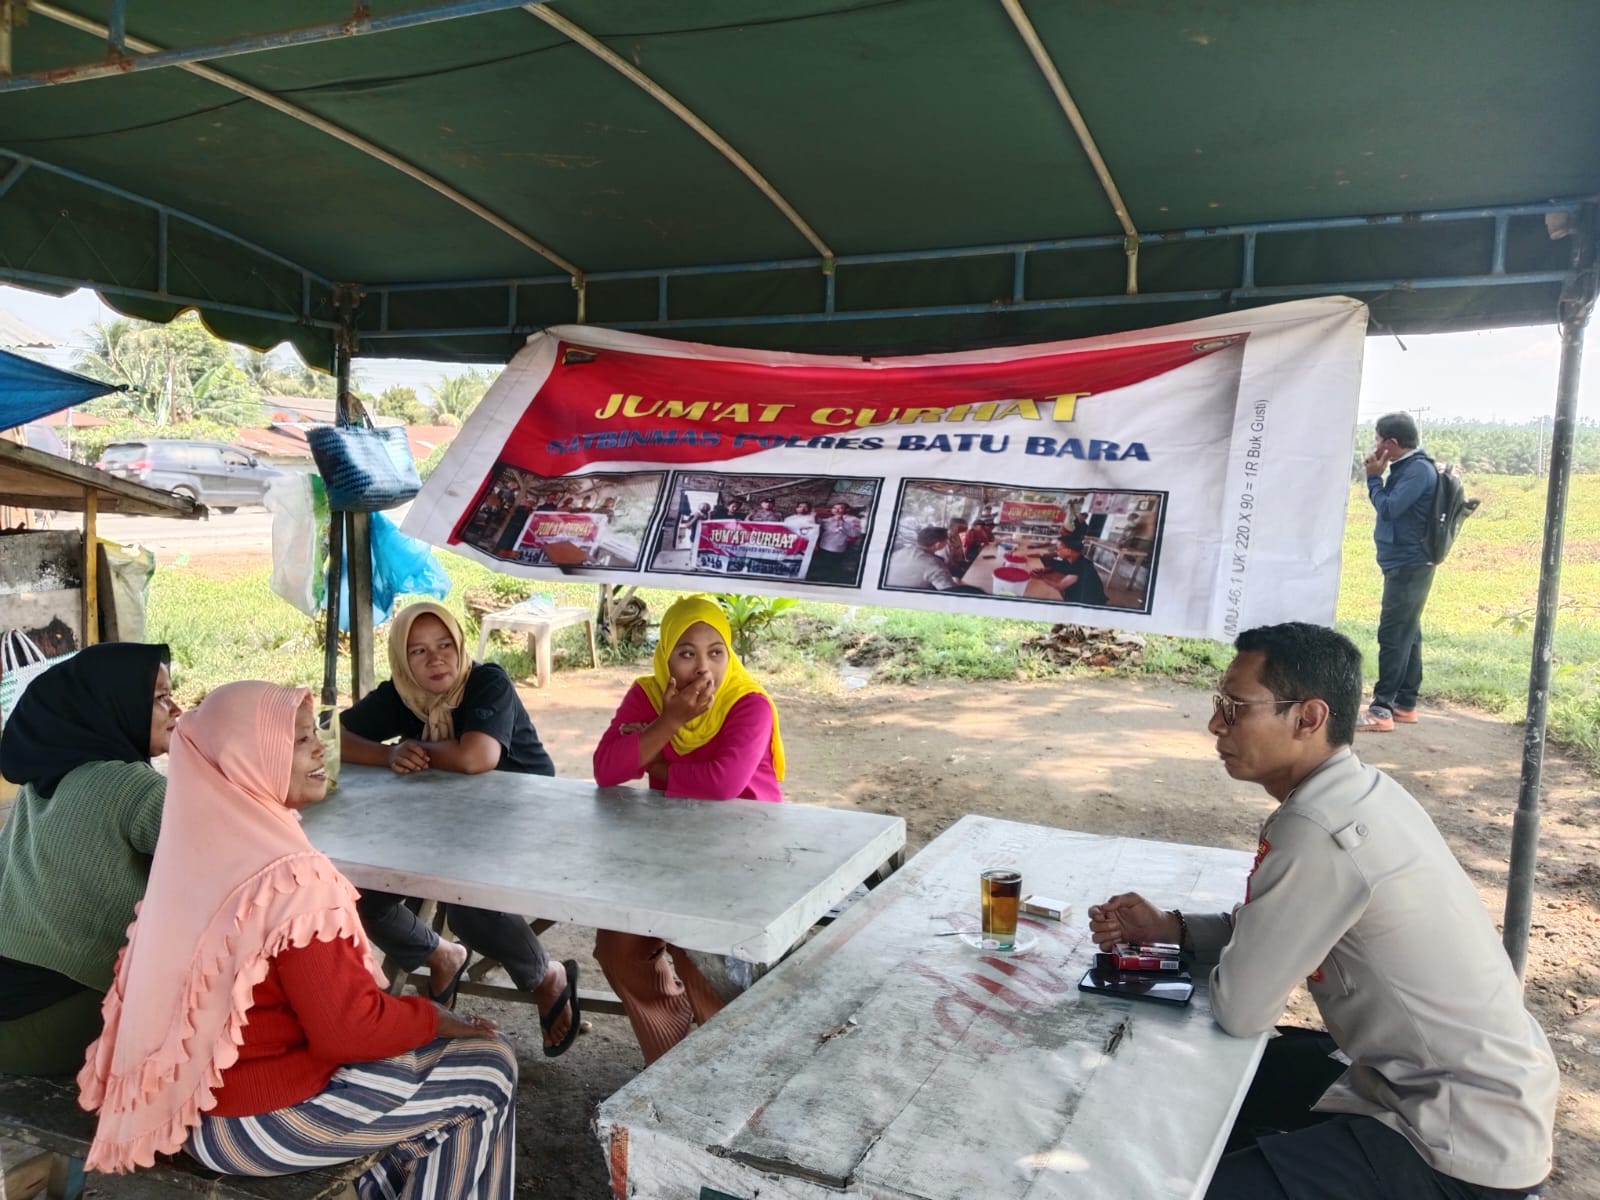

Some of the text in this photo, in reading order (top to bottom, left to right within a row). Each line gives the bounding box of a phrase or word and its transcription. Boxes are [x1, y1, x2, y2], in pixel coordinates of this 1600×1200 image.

[595, 391, 1091, 428] JUM'AT CURHAT
[1250, 399, 1270, 433] Gusti)
[546, 429, 1150, 461] SATBINMAS POLRES BATU BARA
[1247, 435, 1262, 458] Buk
[1240, 493, 1254, 510] 90
[1238, 512, 1252, 523] X
[749, 530, 798, 549] CURHAT
[1235, 525, 1251, 550] 220
[1232, 552, 1247, 574] UK
